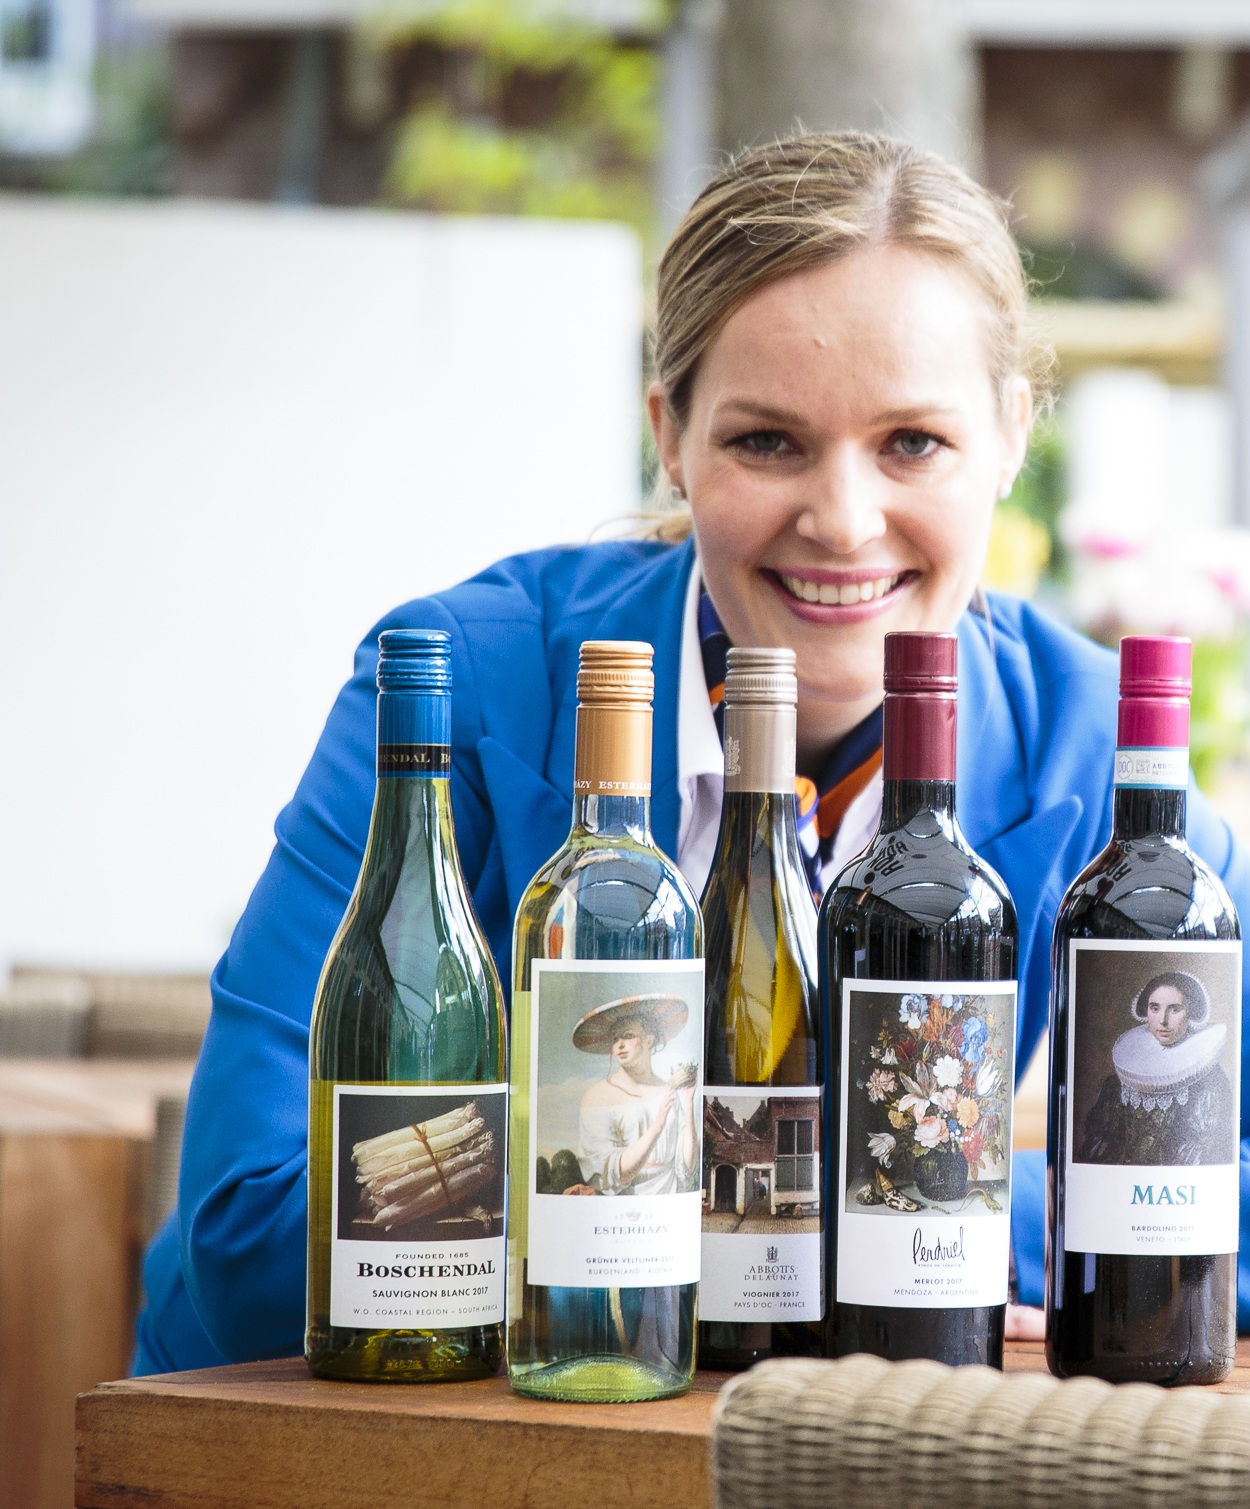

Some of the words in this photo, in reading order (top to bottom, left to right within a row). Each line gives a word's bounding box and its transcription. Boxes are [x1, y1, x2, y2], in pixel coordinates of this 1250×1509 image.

[1130, 1184, 1197, 1206] MASI
[593, 1223, 669, 1235] ESTERHÁZY
[912, 1226, 966, 1265] Perdriel
[585, 1256, 619, 1264] GRÜNER
[621, 1256, 659, 1264] VELTLINER
[356, 1260, 496, 1278] BOSCHENDAL
[372, 1289, 438, 1299] SAUVIGNON
[441, 1288, 471, 1297] BLANC
[472, 1286, 489, 1296] 2017
[893, 1288, 933, 1296] MENDOZA
[940, 1288, 979, 1296] ARGENTINA
[375, 1308, 412, 1316] COASTAL
[458, 1306, 480, 1314] SOUTH
[481, 1304, 498, 1312] AFRICA
